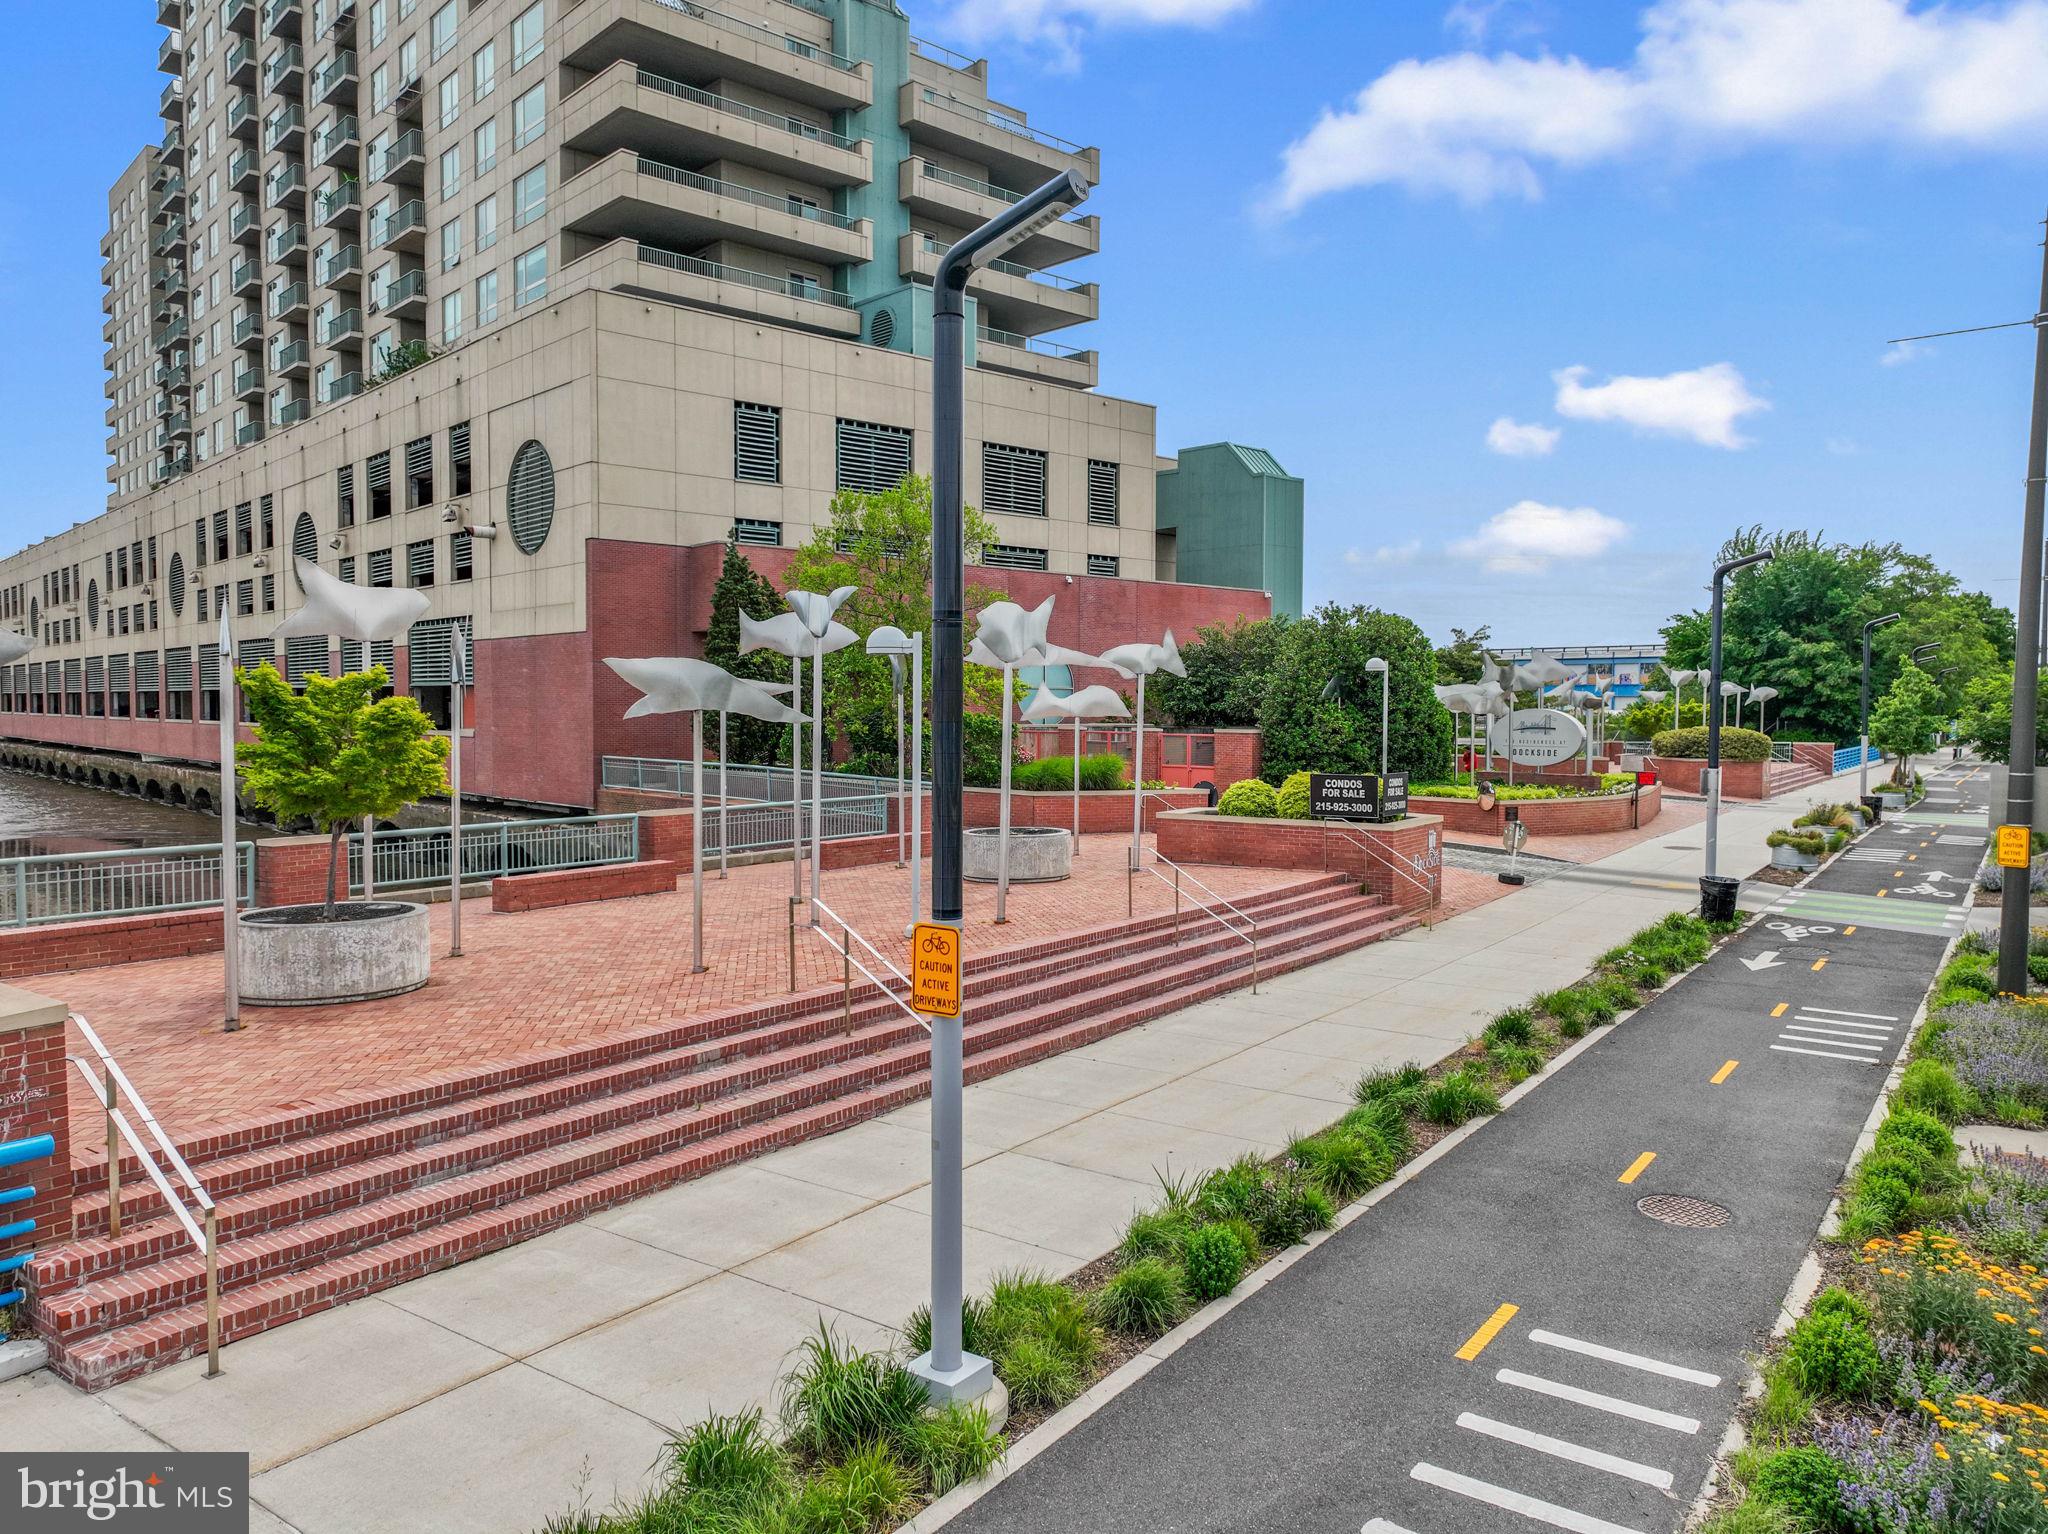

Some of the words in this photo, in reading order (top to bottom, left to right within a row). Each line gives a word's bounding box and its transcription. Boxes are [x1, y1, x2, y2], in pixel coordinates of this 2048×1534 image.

[1512, 749, 1558, 757] DOCKSIDE
[1324, 779, 1363, 789] CONDOS
[1322, 788, 1341, 798] FOR
[1342, 789, 1366, 799] SALE
[1315, 802, 1373, 813] 215-925-3000
[919, 960, 953, 974] CAUTION
[922, 978, 950, 992] ACTIVE
[915, 994, 957, 1010] DRIVEWAYS
